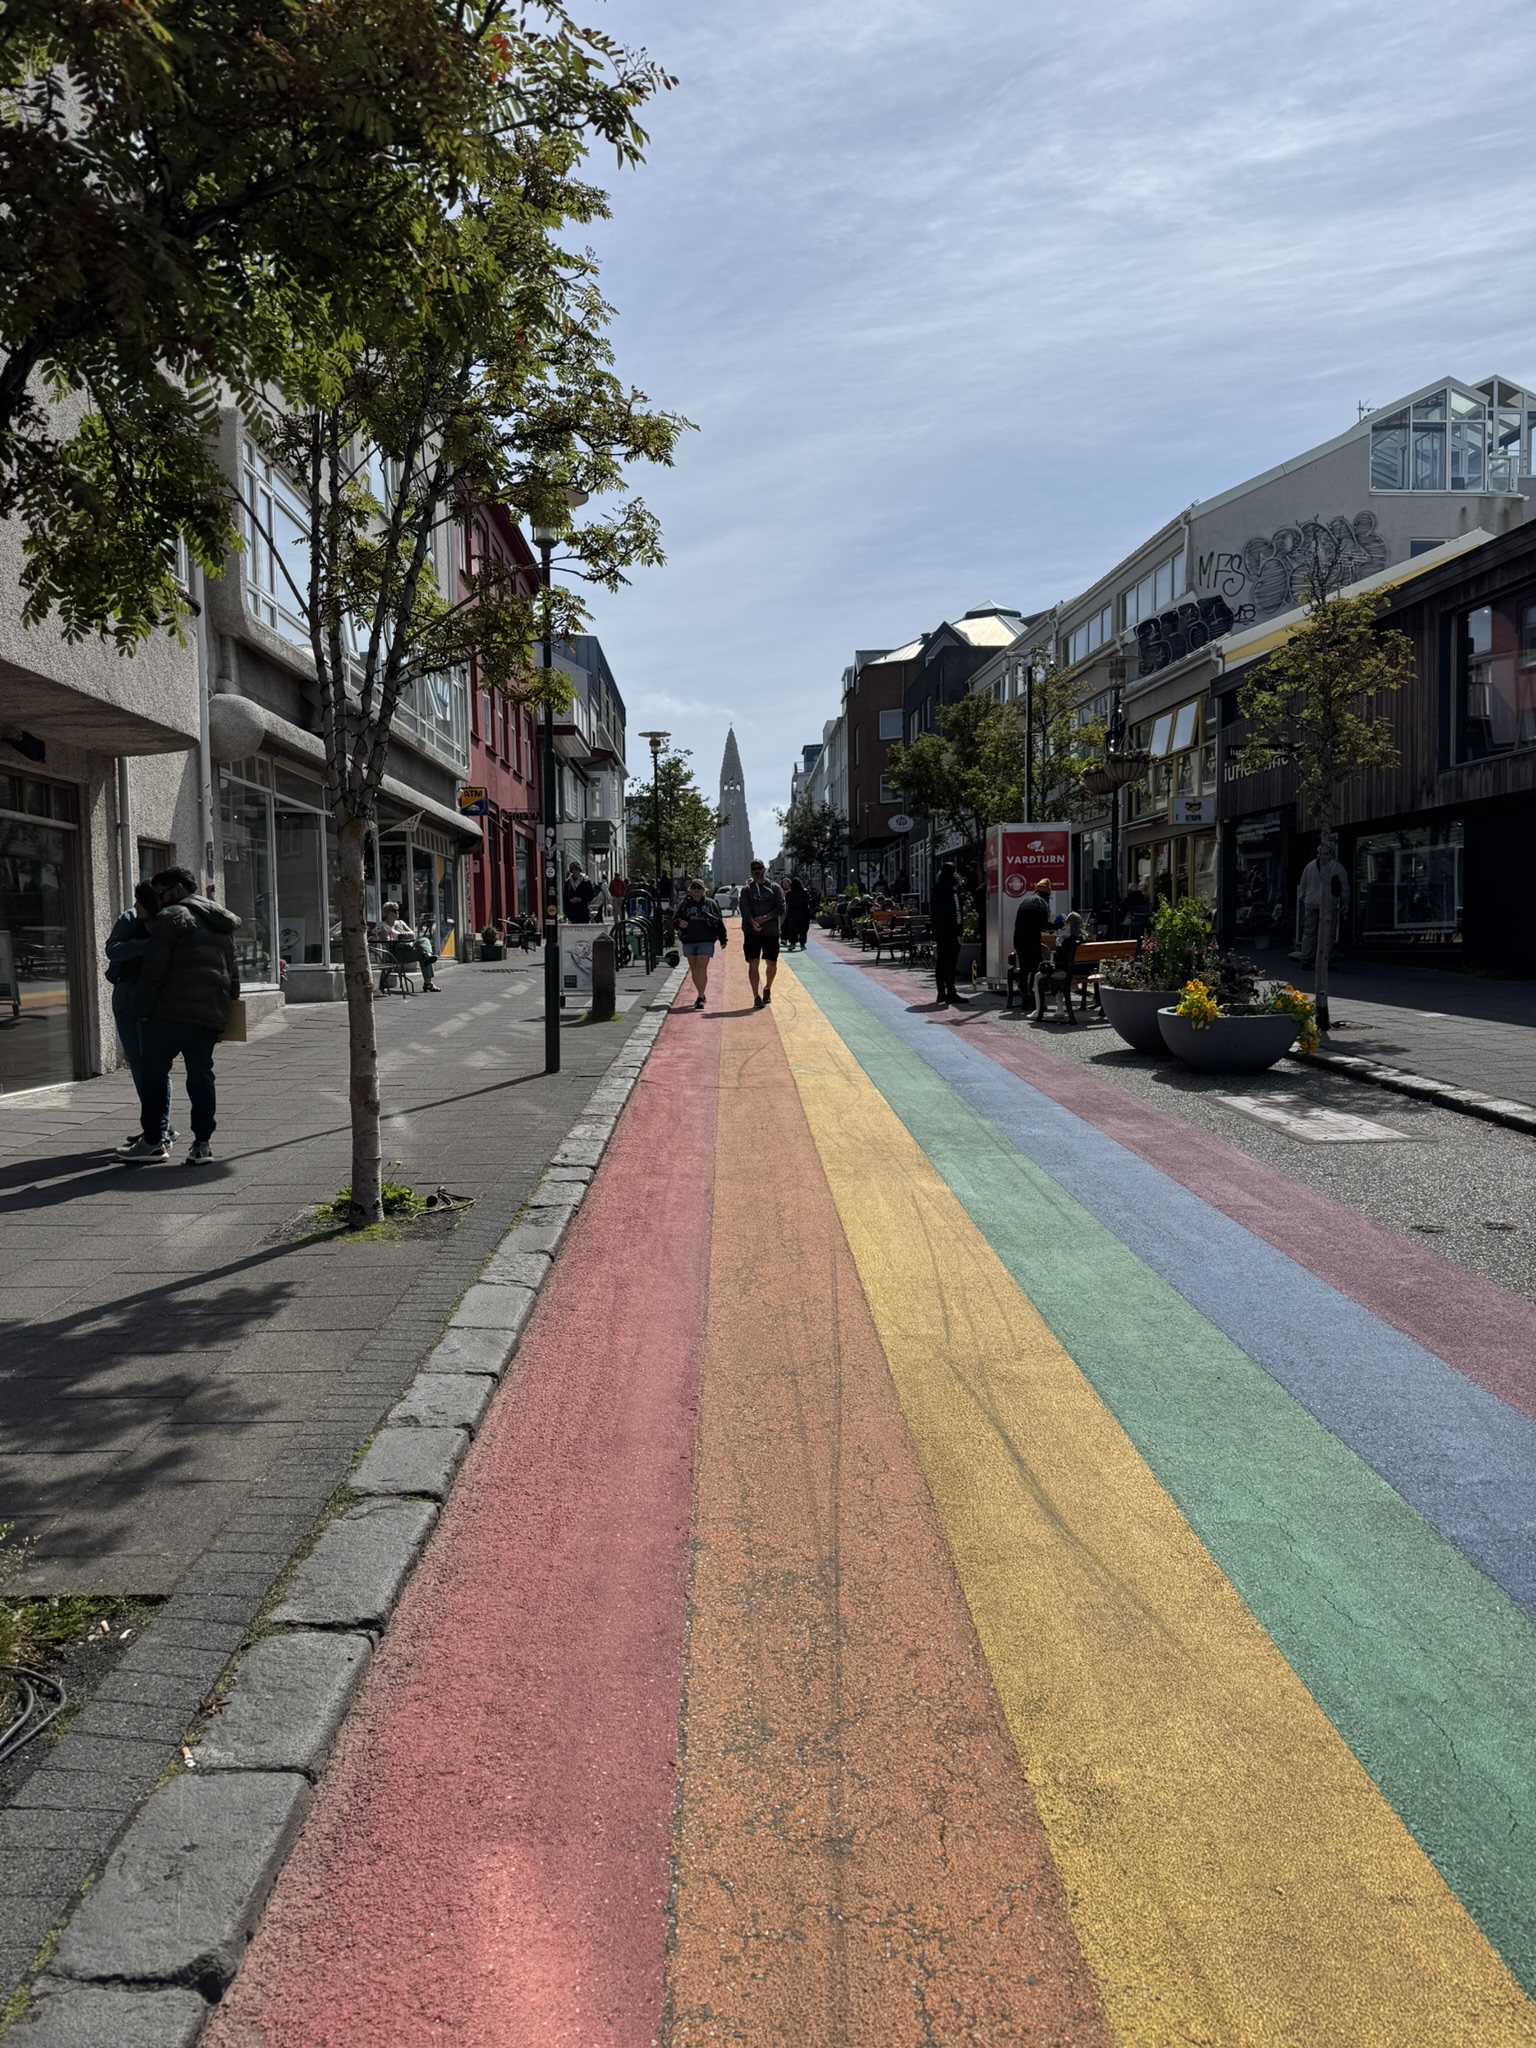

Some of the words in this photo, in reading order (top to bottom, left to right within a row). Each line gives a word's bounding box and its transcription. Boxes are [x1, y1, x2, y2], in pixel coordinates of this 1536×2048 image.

[1198, 550, 1246, 597] MFS
[464, 790, 483, 798] ATM
[1006, 854, 1065, 865] VARÐTURN
